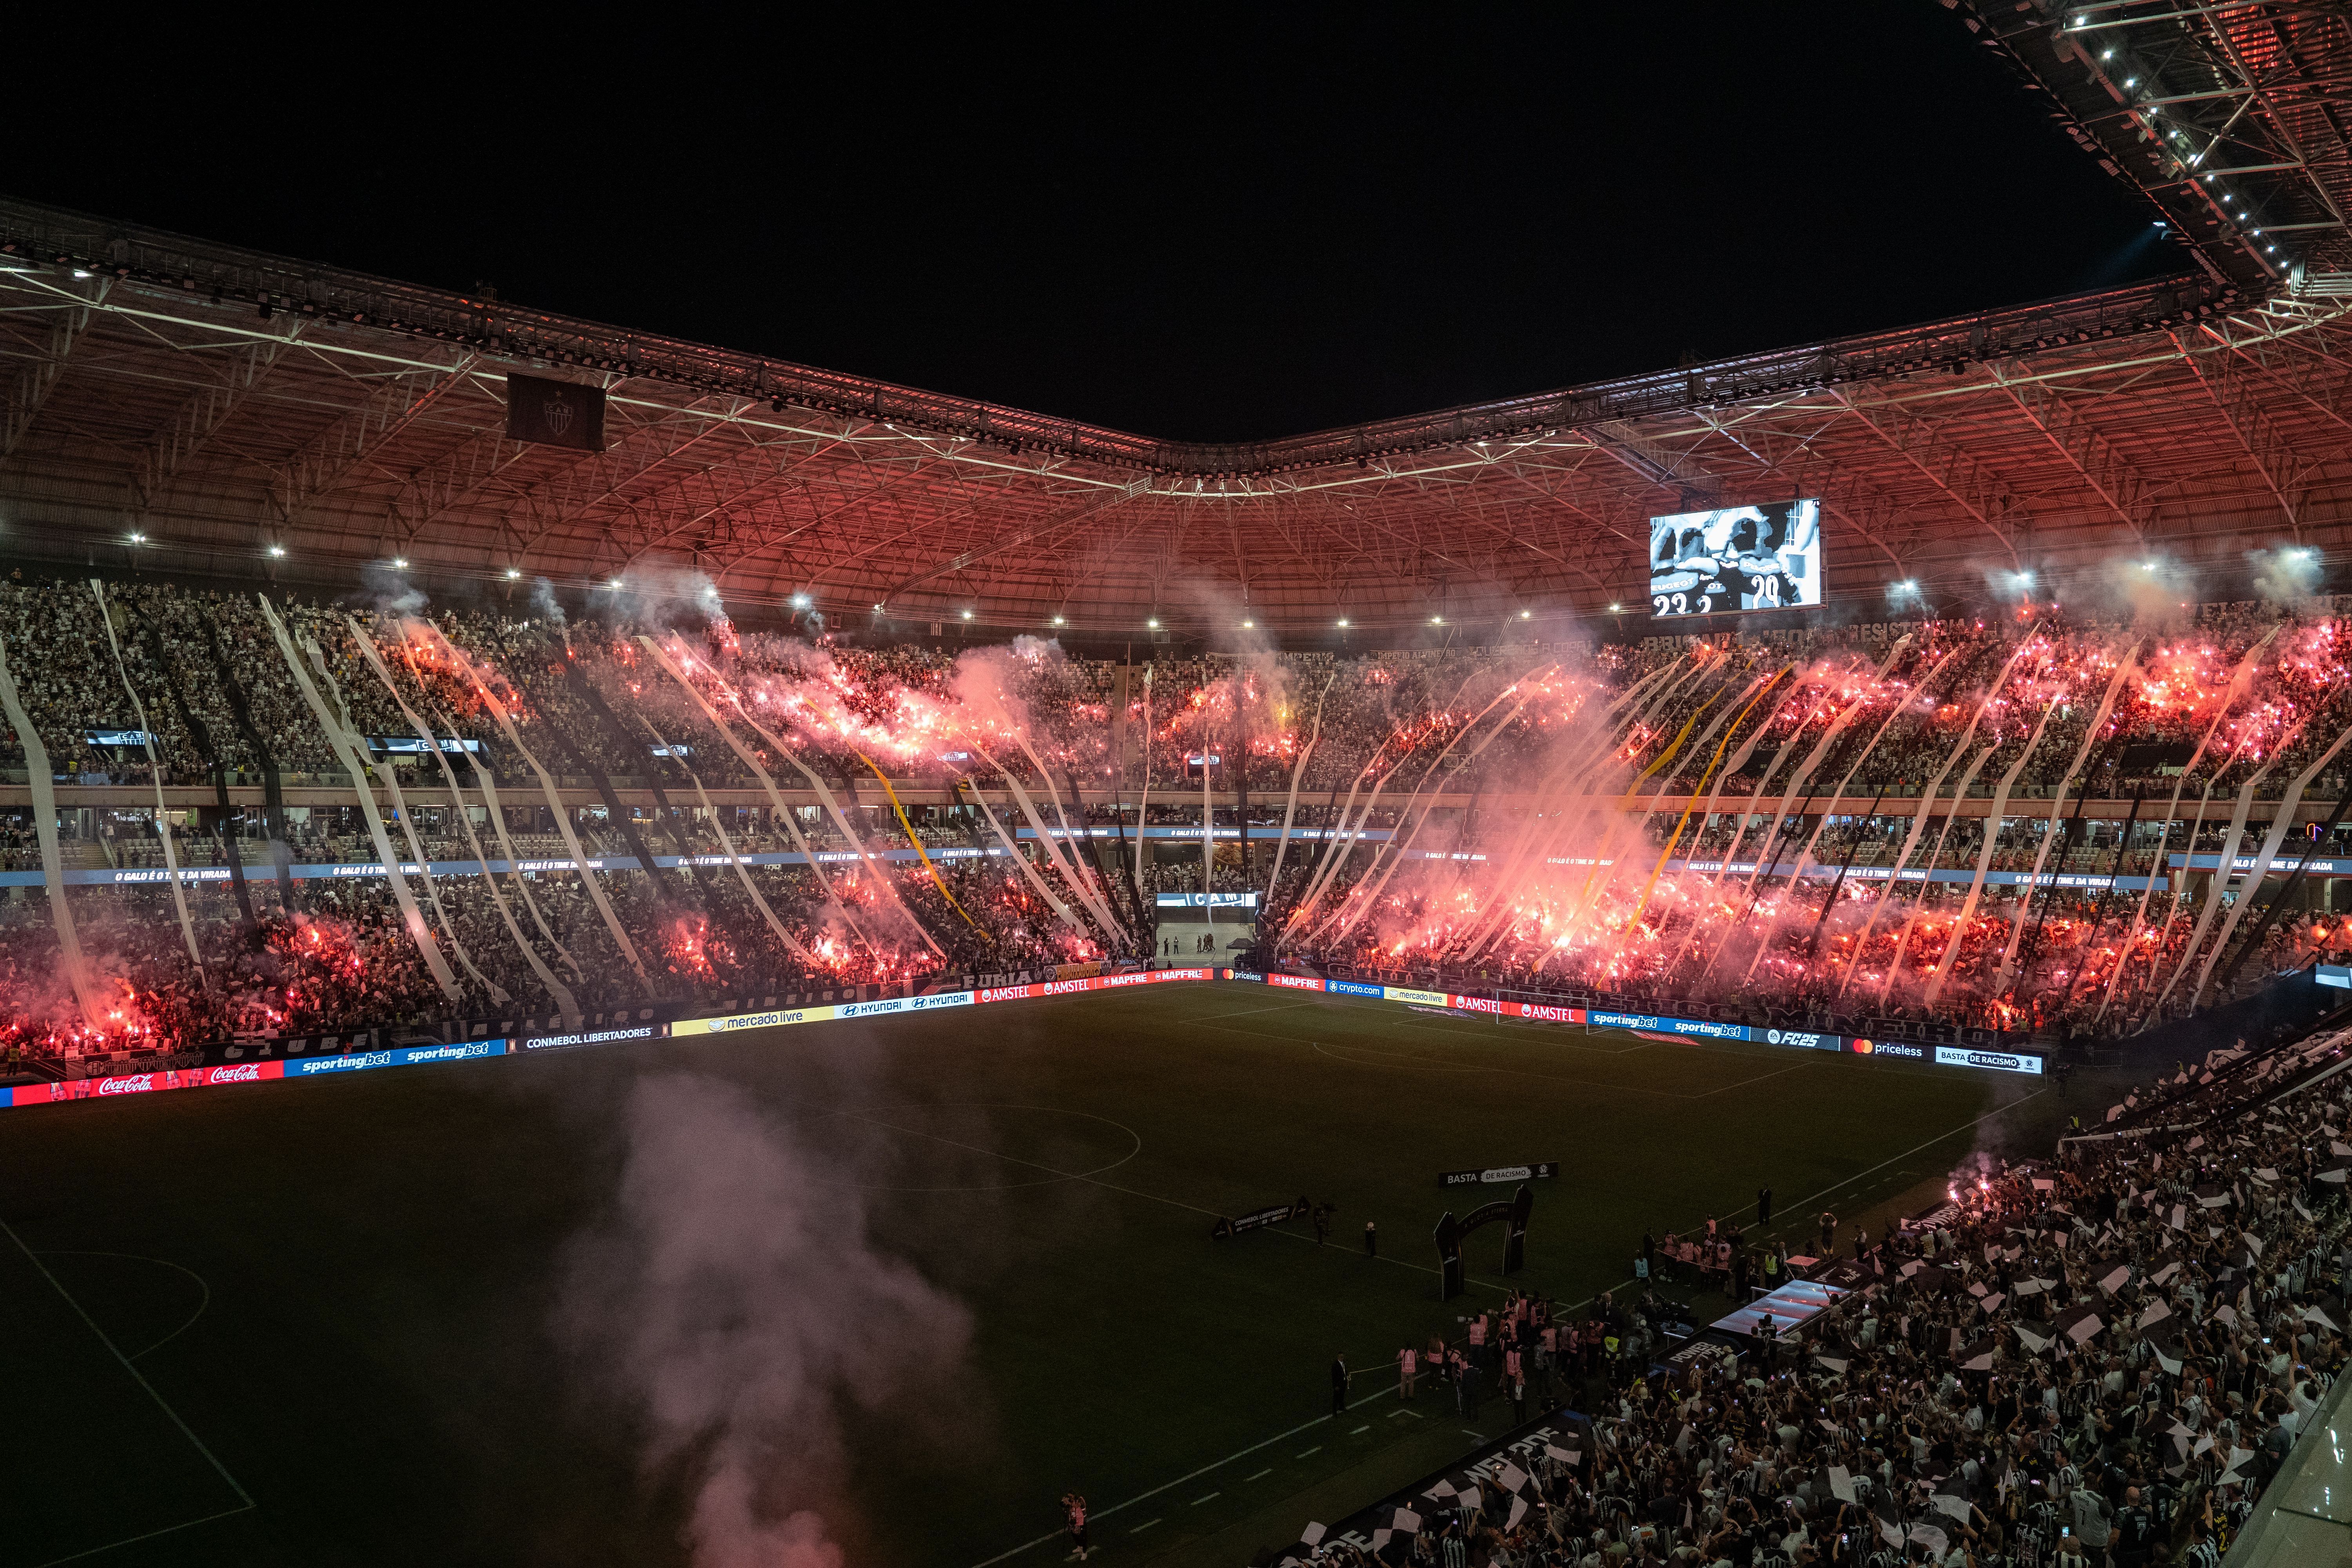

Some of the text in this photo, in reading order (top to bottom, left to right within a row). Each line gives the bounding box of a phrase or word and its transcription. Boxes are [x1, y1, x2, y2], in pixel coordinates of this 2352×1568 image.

[421, 740, 448, 748] CM
[361, 865, 367, 874] É
[542, 861, 547, 869] É
[124, 872, 148, 880] GALO
[149, 870, 155, 880] É
[1862, 868, 1867, 877] É
[2043, 874, 2048, 884] É
[1195, 893, 1238, 905] CAM
[1057, 961, 1100, 981] EMBAIXADORES
[1162, 969, 1203, 980] MAPFRE
[1235, 972, 1261, 981] priceless
[963, 971, 1033, 989] FURIA
[1054, 979, 1088, 993] AMSTEL
[1111, 973, 1147, 985] MAPFRE
[1281, 976, 1319, 989] MAPFRE
[993, 985, 1029, 1001] AMSTEL
[1339, 984, 1380, 996] crypto.com
[1399, 991, 1443, 1003] mercado livre
[929, 994, 967, 1005] HYUNDAI
[1466, 997, 1502, 1014] AMSTEL
[861, 1001, 902, 1013] HYUNDAI
[1532, 1006, 1573, 1022] AMSTEL
[728, 1011, 803, 1028] mercado livre
[1594, 1014, 1658, 1029] sportingbet
[1675, 1021, 1740, 1038] sportingbet
[526, 1029, 651, 1049] CONMEBOL LIBERTADORES
[407, 1041, 489, 1062] sportingbet
[1875, 1043, 1922, 1057] priceless
[303, 1051, 391, 1073] sportingbet
[1941, 1051, 2017, 1067] BASTA DE RACISMO
[211, 1063, 260, 1083] Coca-Cola
[99, 1074, 154, 1095] Coca-Cola
[1447, 1174, 1477, 1183] BASTA
[1496, 1170, 1526, 1179] RACISMO
[1235, 1215, 1259, 1226] CONMEBOL
[1259, 1207, 1289, 1220] LIBERTADORES
[1669, 1341, 1713, 1363] POWER
